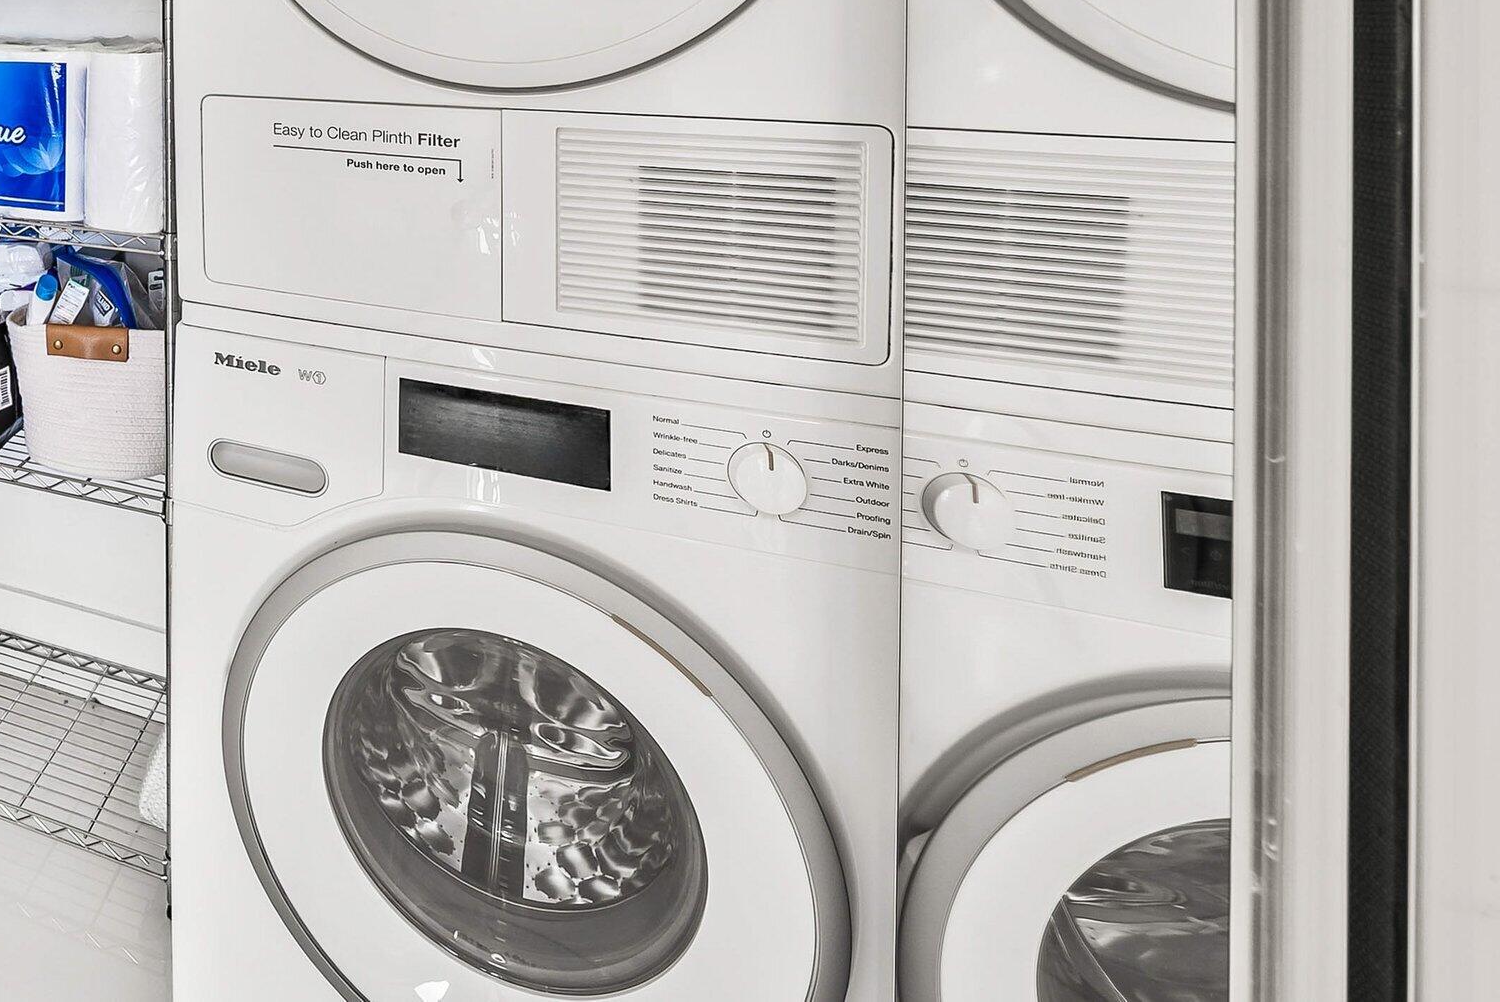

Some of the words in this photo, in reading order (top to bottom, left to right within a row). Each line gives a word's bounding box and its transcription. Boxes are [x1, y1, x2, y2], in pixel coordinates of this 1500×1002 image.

[273, 122, 305, 139] Easy
[310, 126, 322, 138] to
[327, 126, 367, 141] Clean
[372, 129, 412, 144] Plinth
[418, 133, 460, 148] Filter
[346, 159, 373, 170] Push
[376, 161, 400, 172] here
[403, 163, 414, 173] to
[418, 166, 446, 176] open
[214, 352, 281, 375] Miele
[652, 415, 679, 424] Normal
[653, 431, 698, 444] Wrinkle-free
[653, 448, 686, 459] Delicates
[856, 444, 889, 455] Express
[653, 464, 682, 475] Sanitize
[832, 458, 889, 472] Darks/Denims
[653, 480, 692, 491] Handwash
[843, 478, 864, 486] Extra
[866, 481, 890, 490] White
[653, 493, 674, 503] Dress
[676, 497, 698, 507] Shirts
[856, 496, 890, 507] Outdoor
[857, 513, 890, 525] Proofing
[848, 527, 891, 539] Drain/Spin
